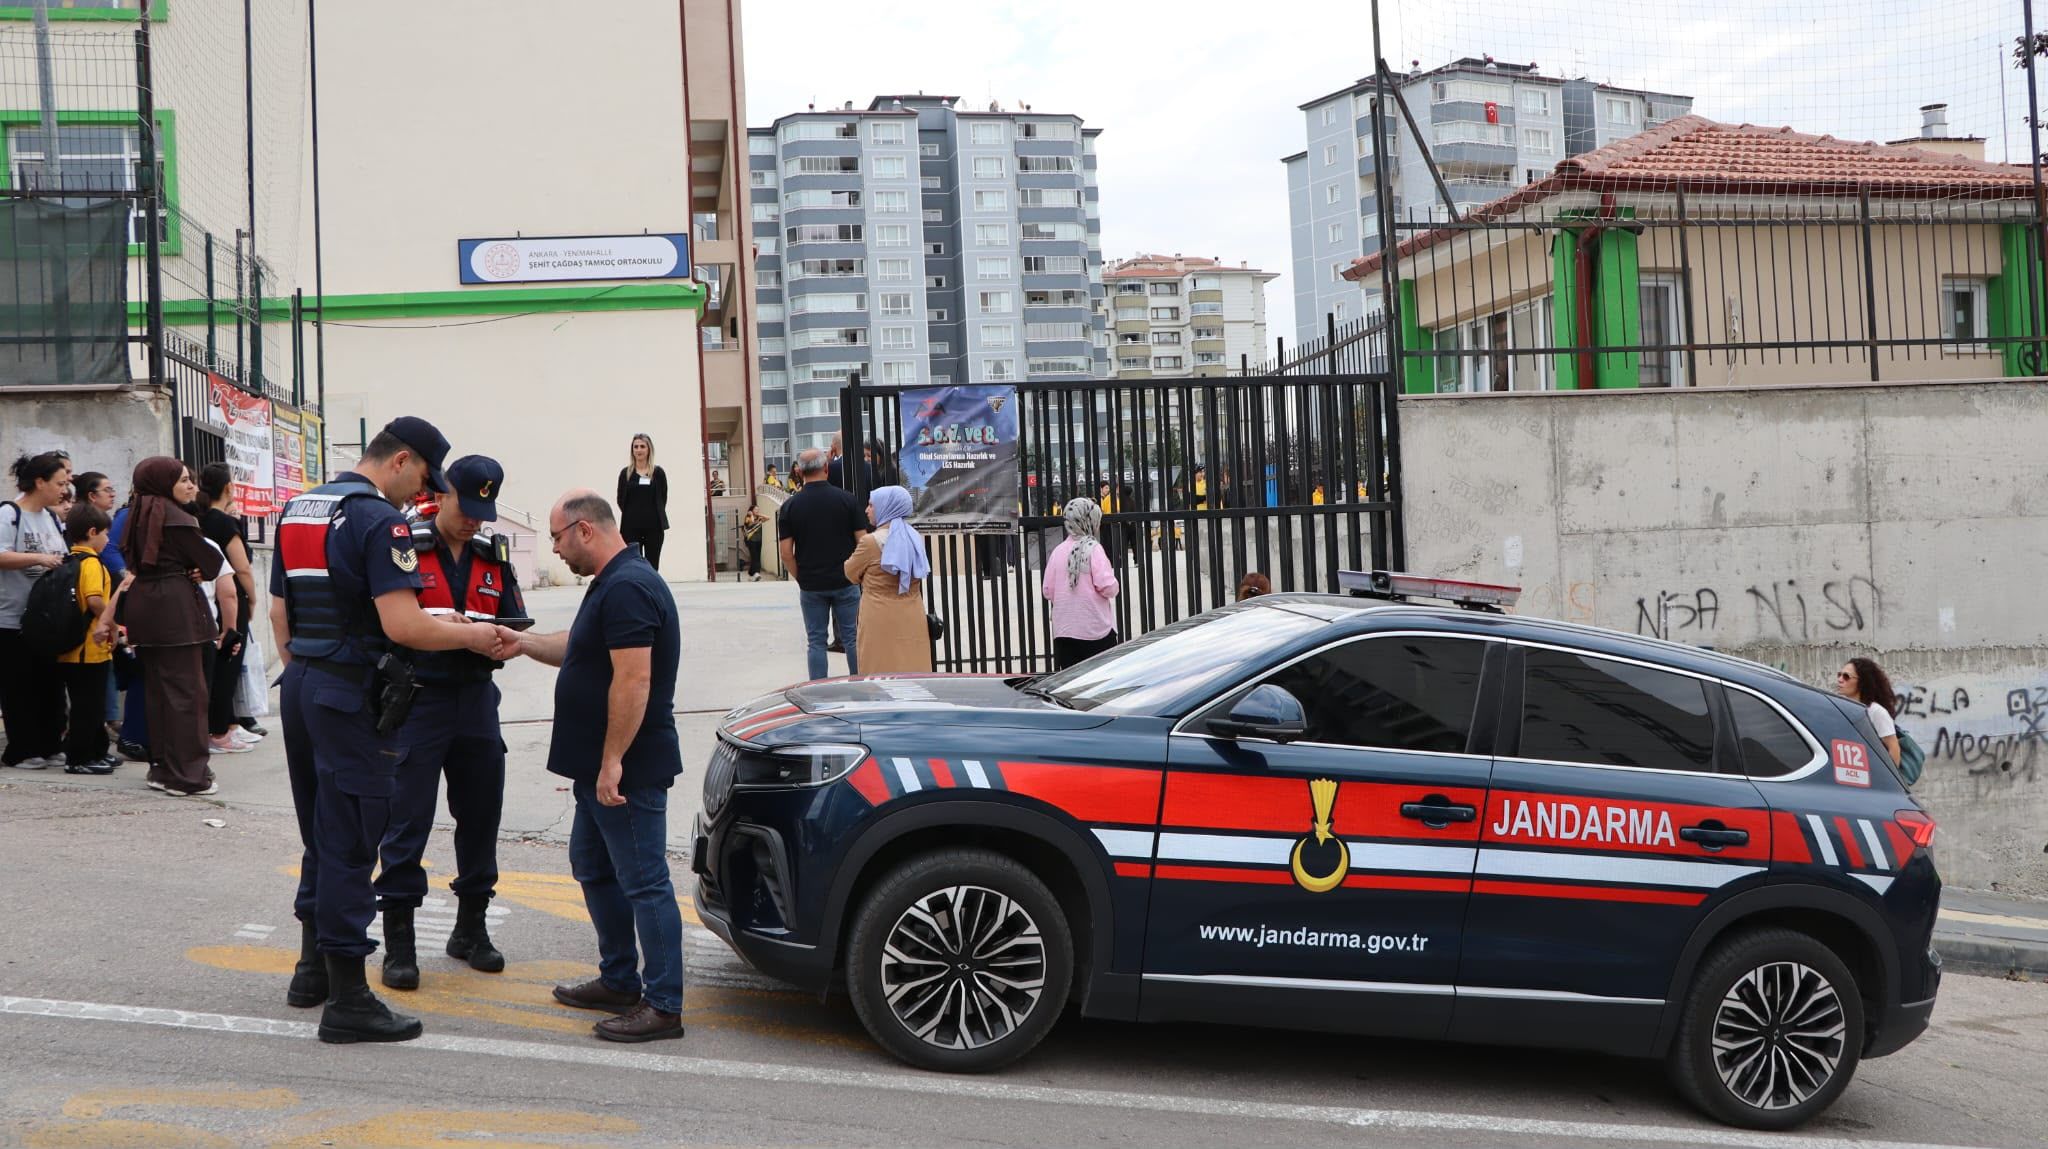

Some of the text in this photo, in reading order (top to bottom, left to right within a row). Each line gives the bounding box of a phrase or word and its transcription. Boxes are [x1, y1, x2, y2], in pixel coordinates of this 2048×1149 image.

[528, 250, 559, 258] ANKARA
[584, 259, 615, 267] TAMKOÇ
[617, 257, 663, 266] ORTAOKULU
[964, 426, 983, 442] ve
[919, 452, 933, 461] Okul
[1836, 743, 1865, 767] 112
[1493, 799, 1676, 847] JANDARMA
[1199, 924, 1429, 954] www.jandarma.gov.tr
